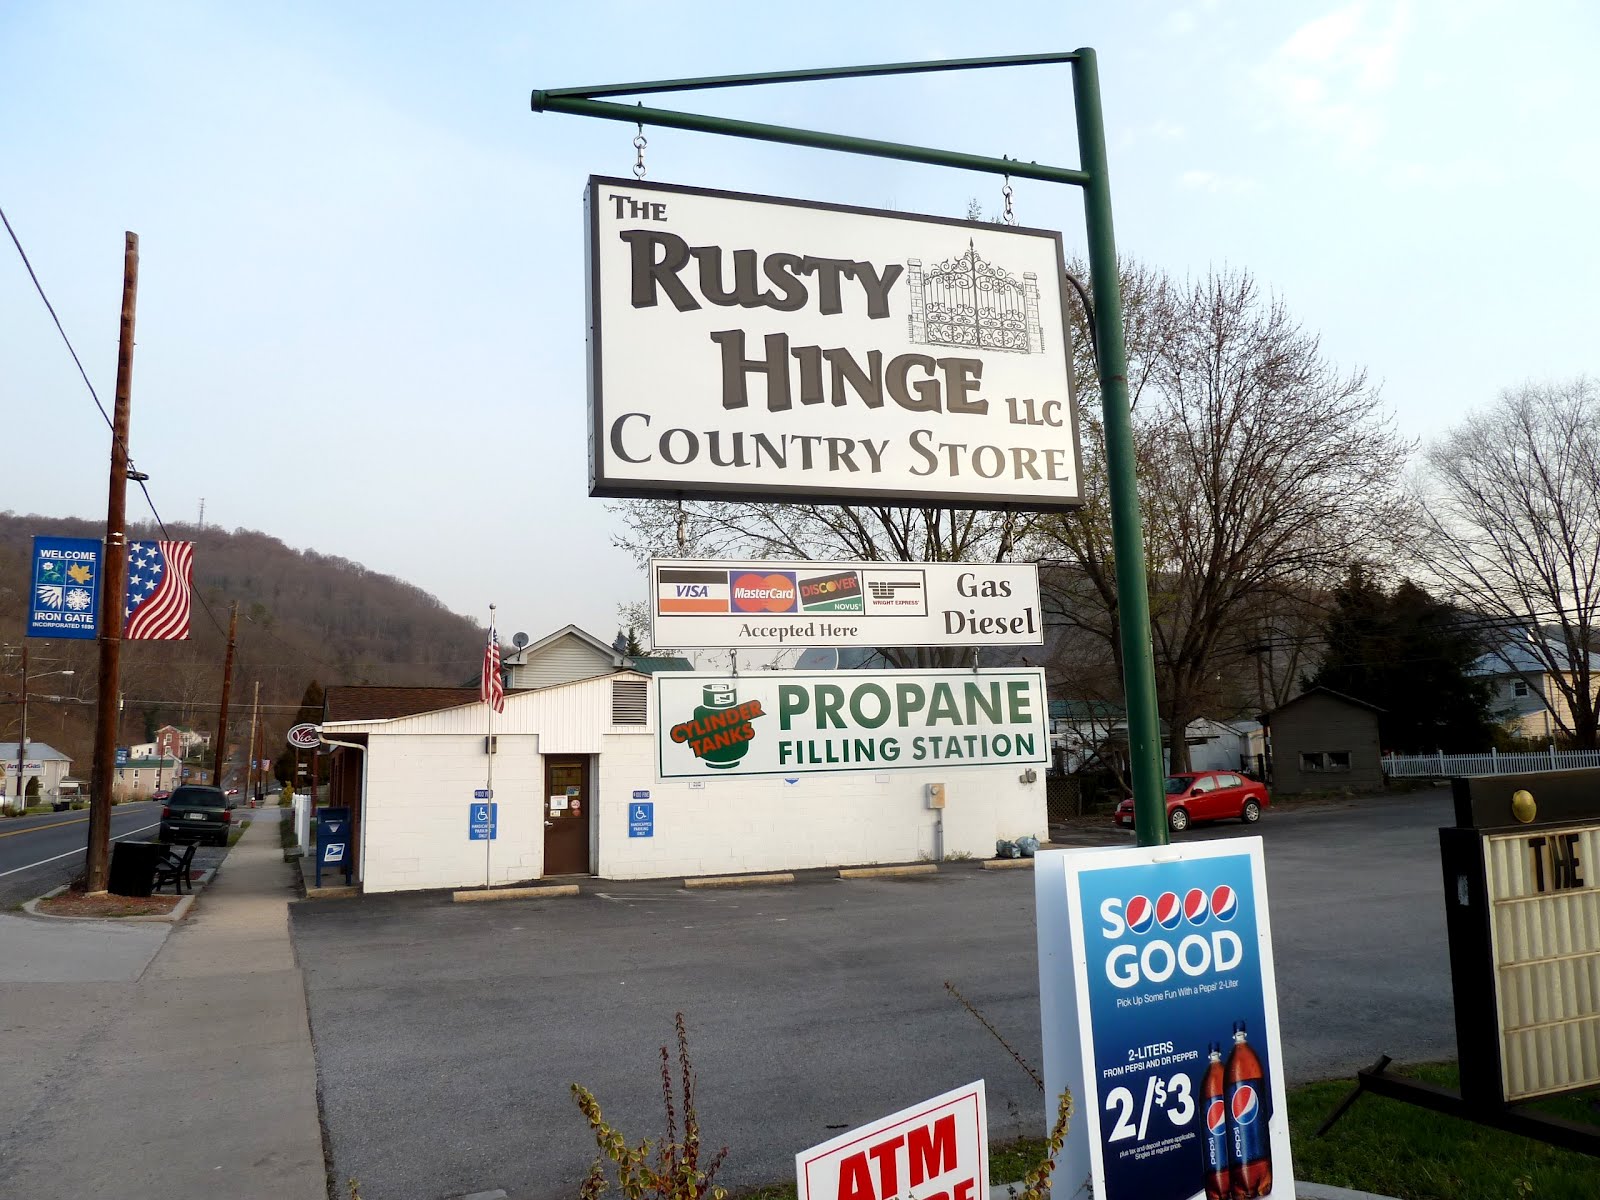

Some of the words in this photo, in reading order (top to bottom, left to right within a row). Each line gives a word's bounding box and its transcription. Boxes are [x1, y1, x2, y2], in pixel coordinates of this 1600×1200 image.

[609, 194, 667, 222] THE
[620, 230, 904, 319] RUSTY
[711, 329, 988, 415] HINGE
[1005, 397, 1063, 427] LLC
[610, 412, 889, 473] COUNTRY
[909, 430, 1069, 481] STORE
[40, 549, 97, 560] WELCOME
[676, 585, 708, 597] VISA
[734, 588, 794, 599] MasterCard
[801, 577, 856, 597] DISCOVER
[956, 572, 1012, 598] Gas
[32, 621, 80, 629] INCORPORATED
[34, 612, 61, 621] IRON
[64, 613, 94, 623] GATE
[941, 608, 1038, 635] Diesel
[739, 622, 815, 642] Accepted
[819, 623, 858, 637] Here
[778, 681, 1033, 731] PROPANE
[671, 700, 766, 743] CYLINDER
[690, 722, 755, 757] TANKS
[779, 737, 901, 764] FILLING
[912, 733, 1035, 761] STATION
[1528, 833, 1584, 892] THE
[1105, 930, 1243, 989] GOOD
[1117, 999, 1132, 1008] Pick
[1133, 996, 1143, 1006] Up
[1144, 992, 1164, 1003] Some
[1165, 990, 1177, 1000] Fun
[1178, 986, 1193, 997] With
[1219, 979, 1239, 990] 2-Liter
[1103, 1067, 1124, 1078] FROM
[1125, 1061, 1145, 1073] PEPSI
[1146, 1059, 1160, 1069] AND
[1161, 1055, 1172, 1065] DR
[1172, 1050, 1198, 1063] PEPPER
[1128, 1041, 1174, 1061] 2-LITERS
[1105, 1072, 1195, 1143] 2/$3
[1208, 1137, 1216, 1165] pepsi
[1233, 1127, 1242, 1157] pepsi
[837, 1113, 958, 1200] ATM
